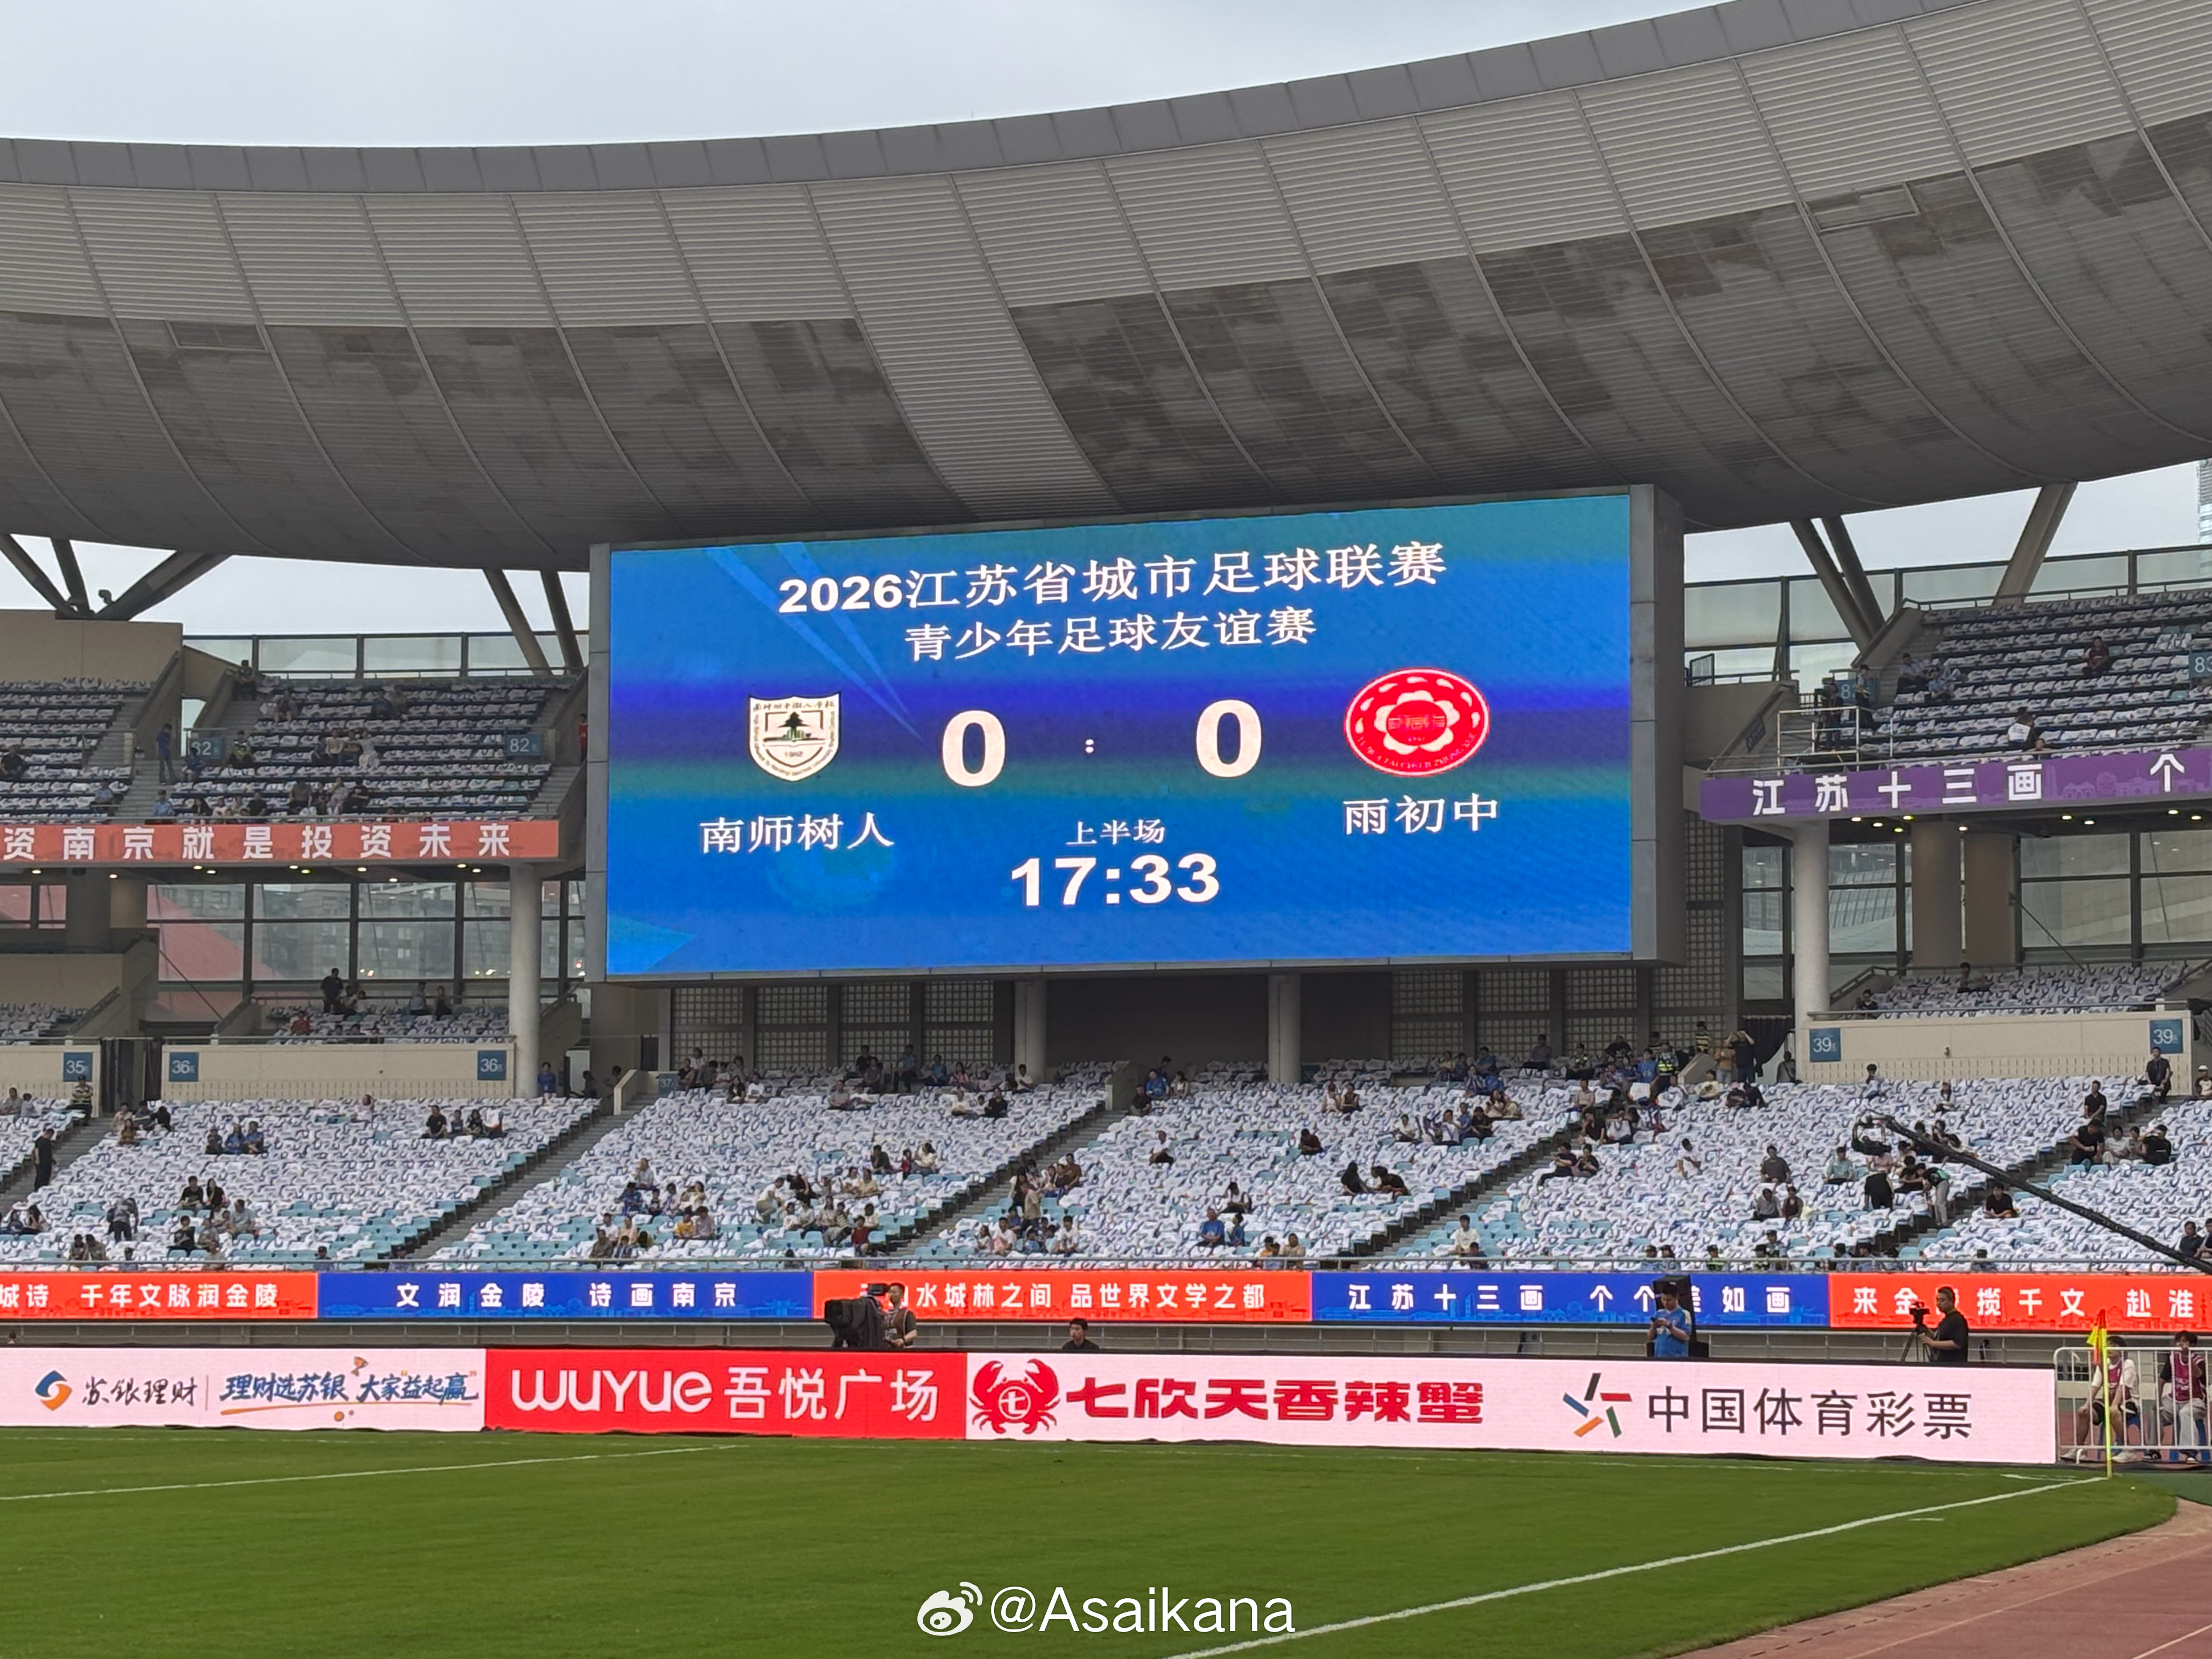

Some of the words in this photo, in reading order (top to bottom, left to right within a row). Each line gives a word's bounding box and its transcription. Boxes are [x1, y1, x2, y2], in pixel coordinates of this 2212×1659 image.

[778, 541, 1447, 614] 2026江苏省城市足球联赛
[904, 606, 1317, 662] 青少年足球友谊赛
[1841, 684, 1856, 699] 8
[943, 710, 1006, 787] 0
[1196, 699, 1262, 778] 0
[1753, 764, 2042, 816] 江苏十三画
[2150, 753, 2185, 792] 个
[1066, 819, 1166, 845] 上半场
[1342, 793, 1498, 834] 雨初中
[3, 824, 510, 860] 资南京就是投资未来
[699, 812, 895, 854] 南师树人
[1011, 853, 1220, 906] 17:33
[81, 1283, 278, 1308] 千年文脉润金陵
[396, 1283, 544, 1307] 文润金陵
[589, 1282, 737, 1307] 诗画南京
[860, 1282, 1051, 1308] 水城林之间
[1071, 1283, 1265, 1309] 品世界文学之都
[1348, 1284, 1543, 1311] 江苏十三画
[1854, 1286, 2085, 1317] 来金揽千文
[2126, 1289, 2194, 1318] 赴淮
[82, 1376, 198, 1407] 苏银理财
[219, 1372, 349, 1402] 理财选苏银
[724, 1367, 938, 1421] 吾悦广场
[1066, 1377, 1483, 1425] 七欣天香辣蟹
[1649, 1386, 1972, 1441] 中国体育彩票
